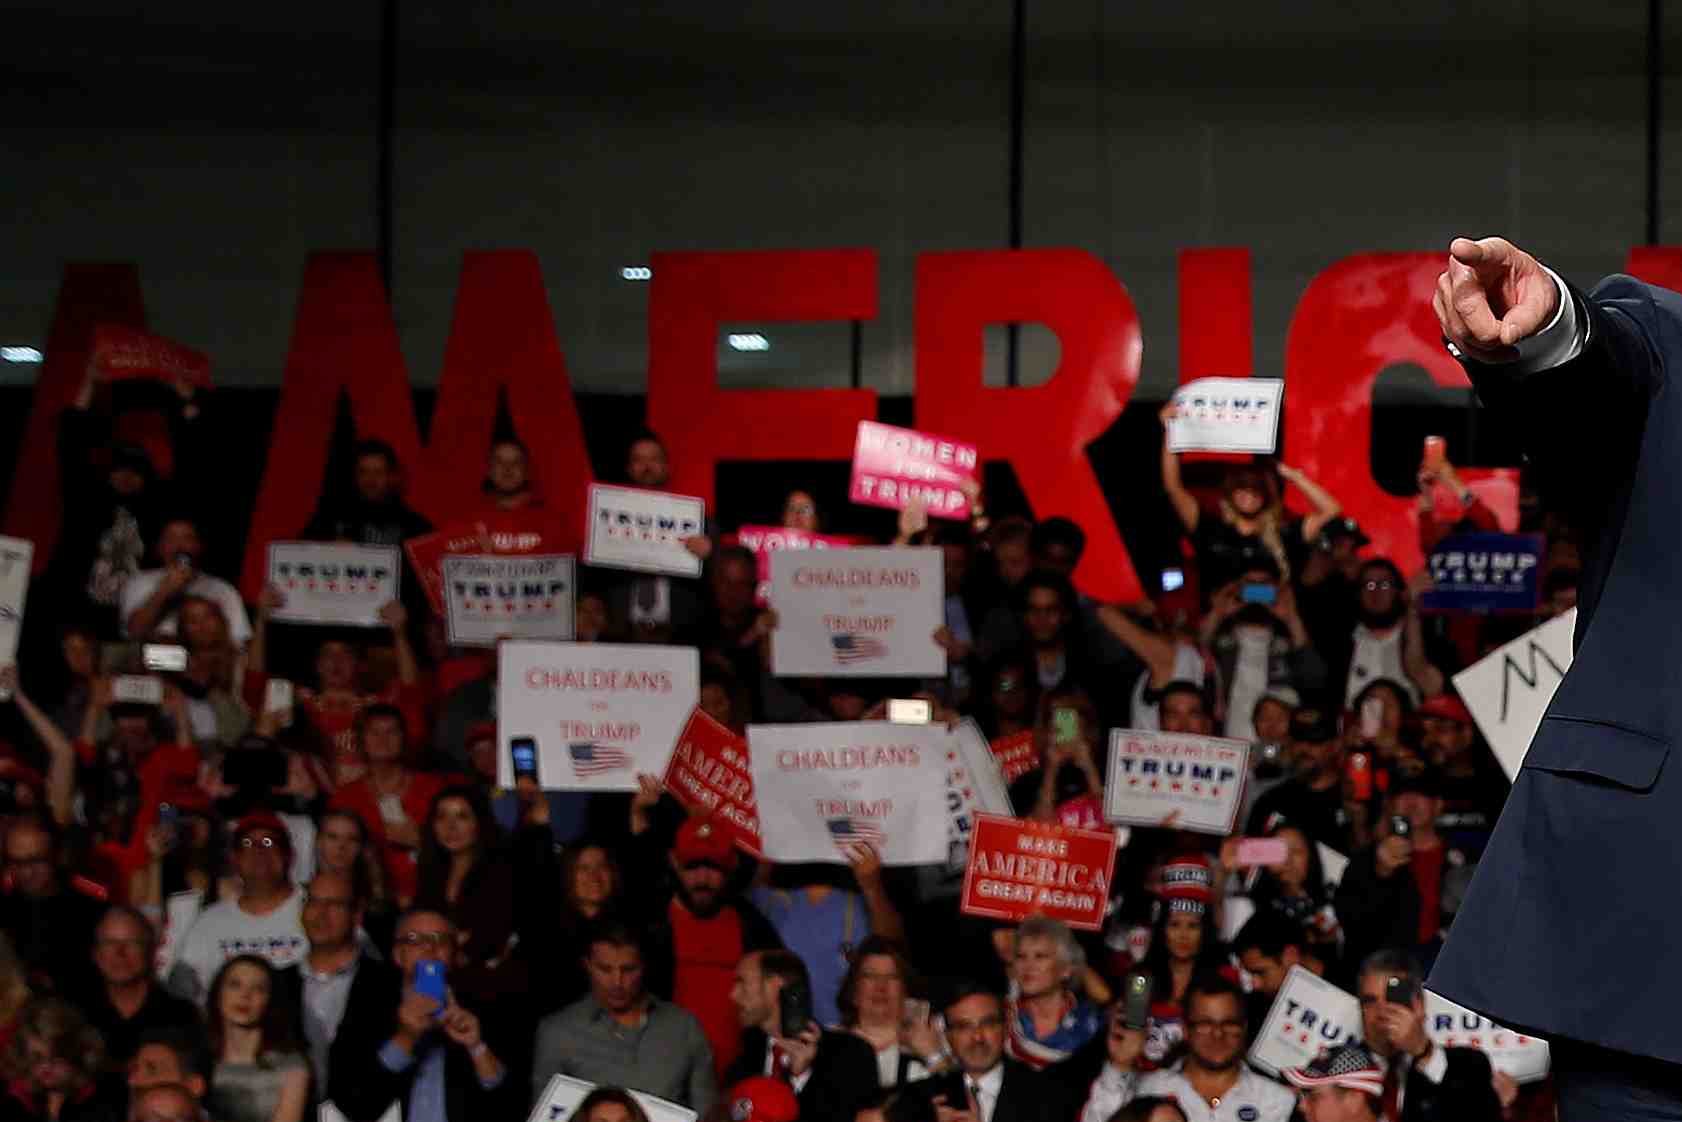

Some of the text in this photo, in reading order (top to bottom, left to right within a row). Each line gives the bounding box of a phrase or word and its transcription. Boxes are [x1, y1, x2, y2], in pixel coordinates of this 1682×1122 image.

[861, 424, 978, 468] WOMEN
[860, 476, 967, 513] TRUMP
[453, 581, 565, 600] TRUMP
[525, 666, 673, 695] CHALDEANS
[775, 744, 921, 772] CHALDEANS
[1120, 757, 1236, 782] TRUMP
[1017, 833, 1069, 858] MAKE
[974, 849, 1109, 891] AMERICA
[976, 879, 1097, 912] GREAT AGAIN
